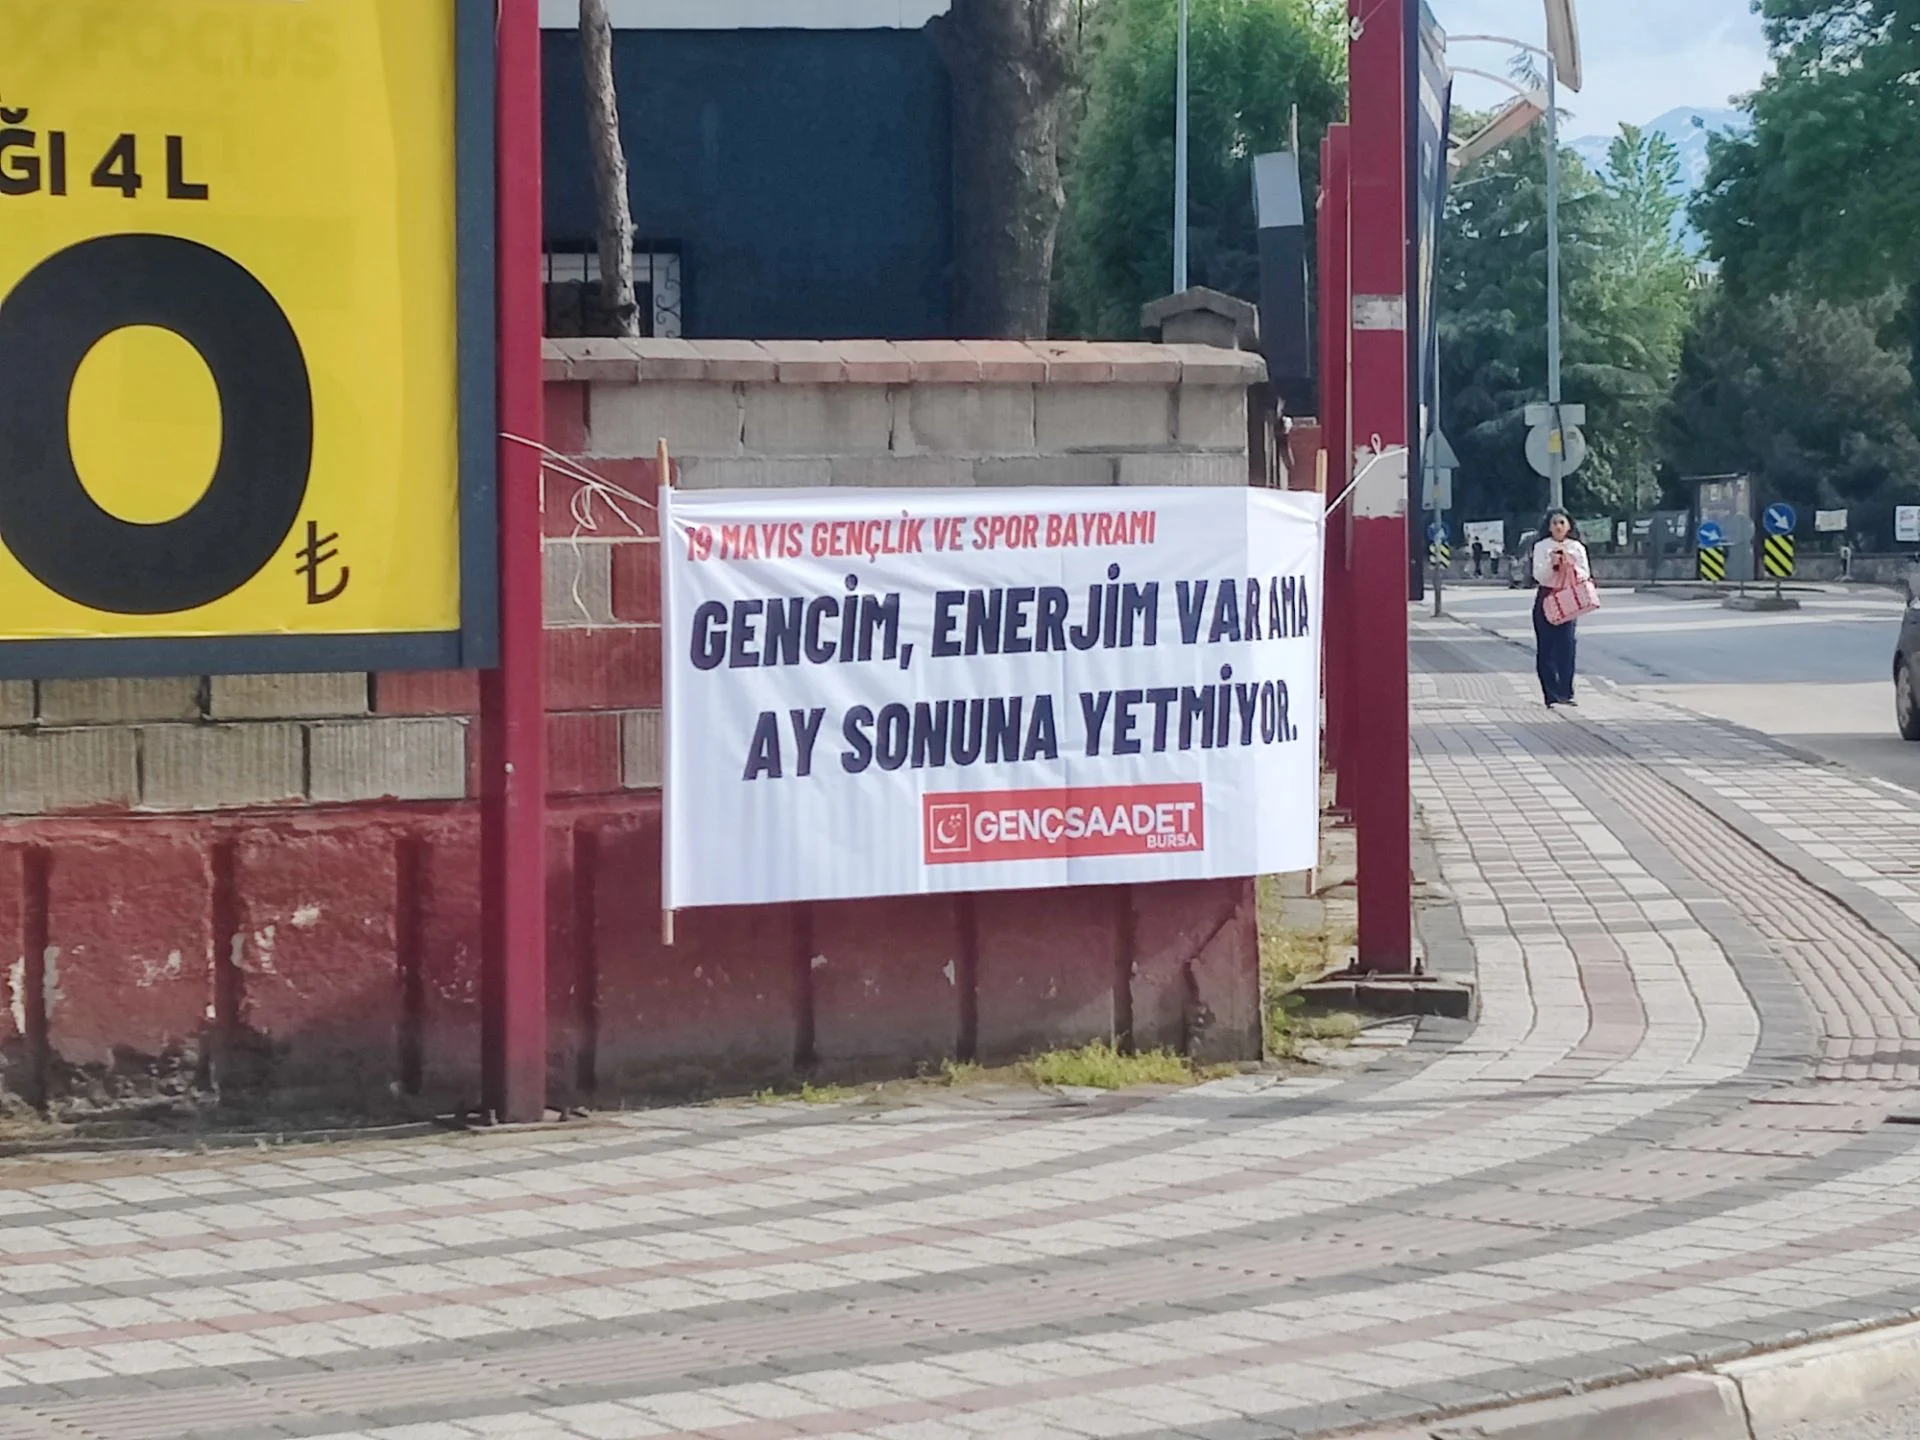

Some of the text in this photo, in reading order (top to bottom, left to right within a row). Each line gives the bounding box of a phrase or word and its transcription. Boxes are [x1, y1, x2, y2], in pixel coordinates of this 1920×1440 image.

[91, 133, 142, 199] 4
[165, 134, 209, 200] L
[684, 508, 1157, 564] 19 MAYIS GENÇLİK VE SPOR BAYRAMI
[690, 562, 1310, 671] GENCİM, ENERJİM VAR AMA
[742, 663, 1298, 781] AY SONUNA YETMİYOR.
[974, 801, 1196, 844] GENÇSAADET
[1146, 833, 1197, 849] BURSA
